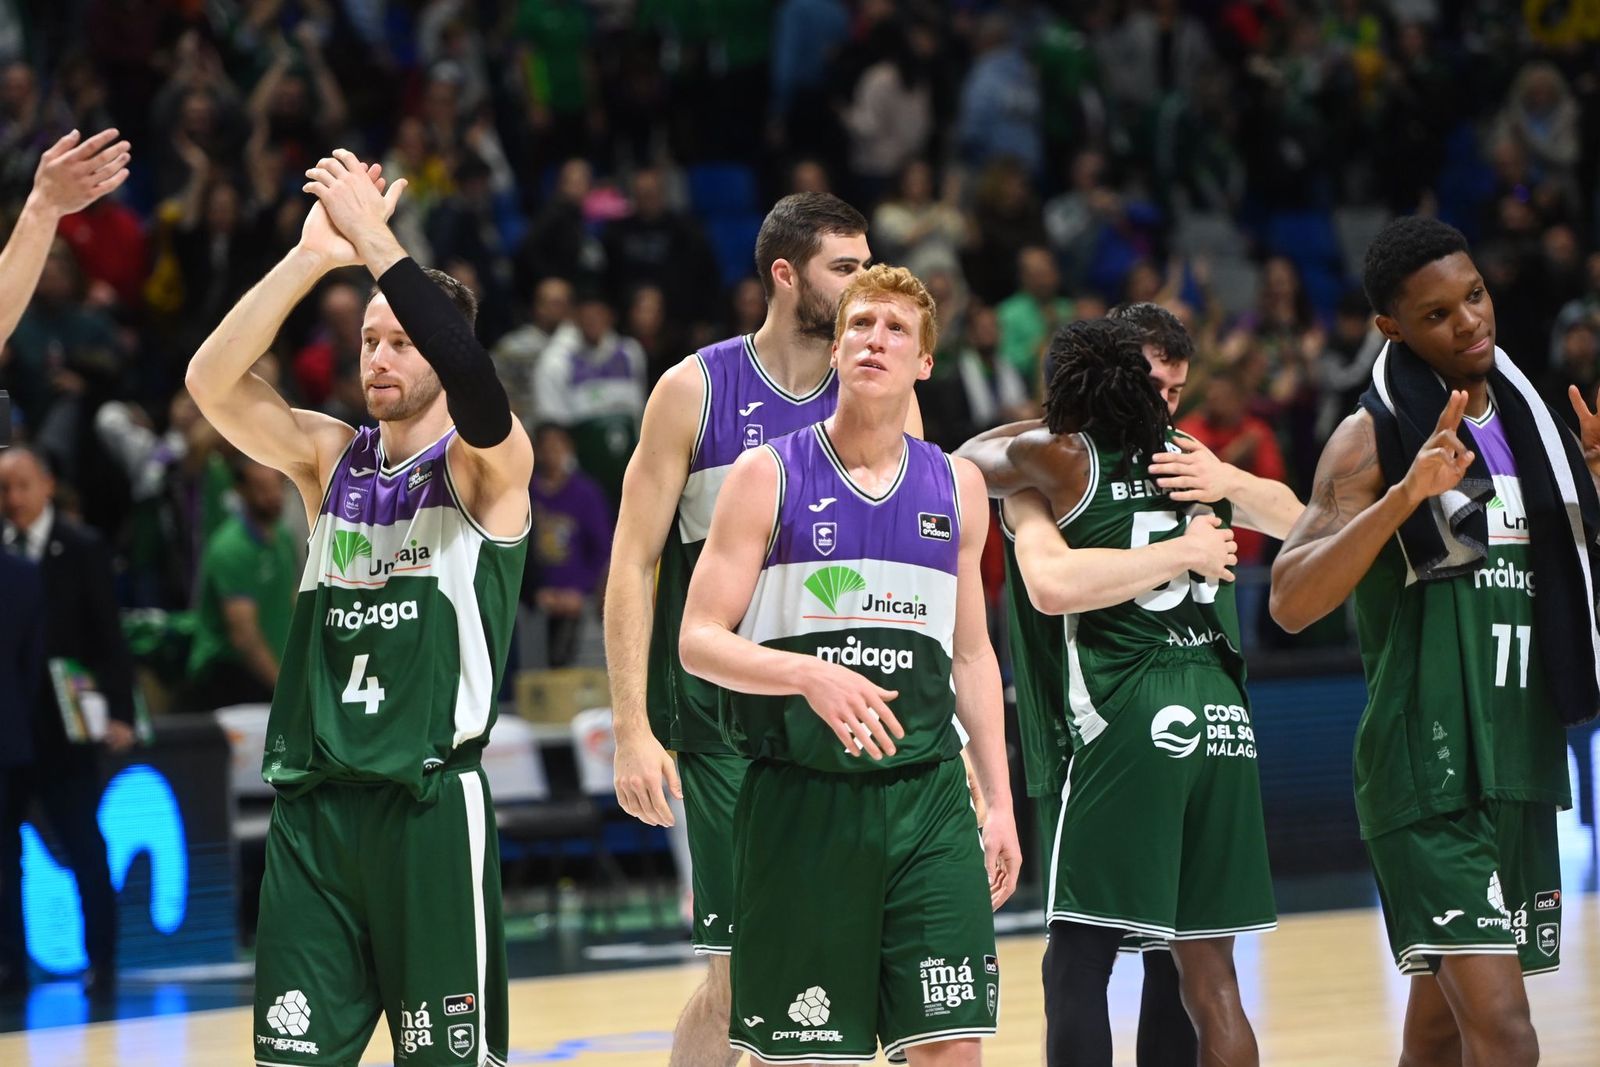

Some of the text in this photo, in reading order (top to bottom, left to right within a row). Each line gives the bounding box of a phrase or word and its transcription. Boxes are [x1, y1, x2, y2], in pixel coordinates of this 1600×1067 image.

[369, 539, 431, 576] Unaja
[1473, 557, 1537, 597] málag
[862, 592, 928, 620] Unicaja
[1492, 624, 1531, 688] 11
[341, 654, 386, 714] 4
[1206, 724, 1255, 743] DEL SO
[1538, 898, 1555, 907] acb
[920, 956, 946, 968] sabor
[920, 956, 975, 985] a má
[447, 1001, 469, 1013] acb
[921, 979, 977, 1007] laga
